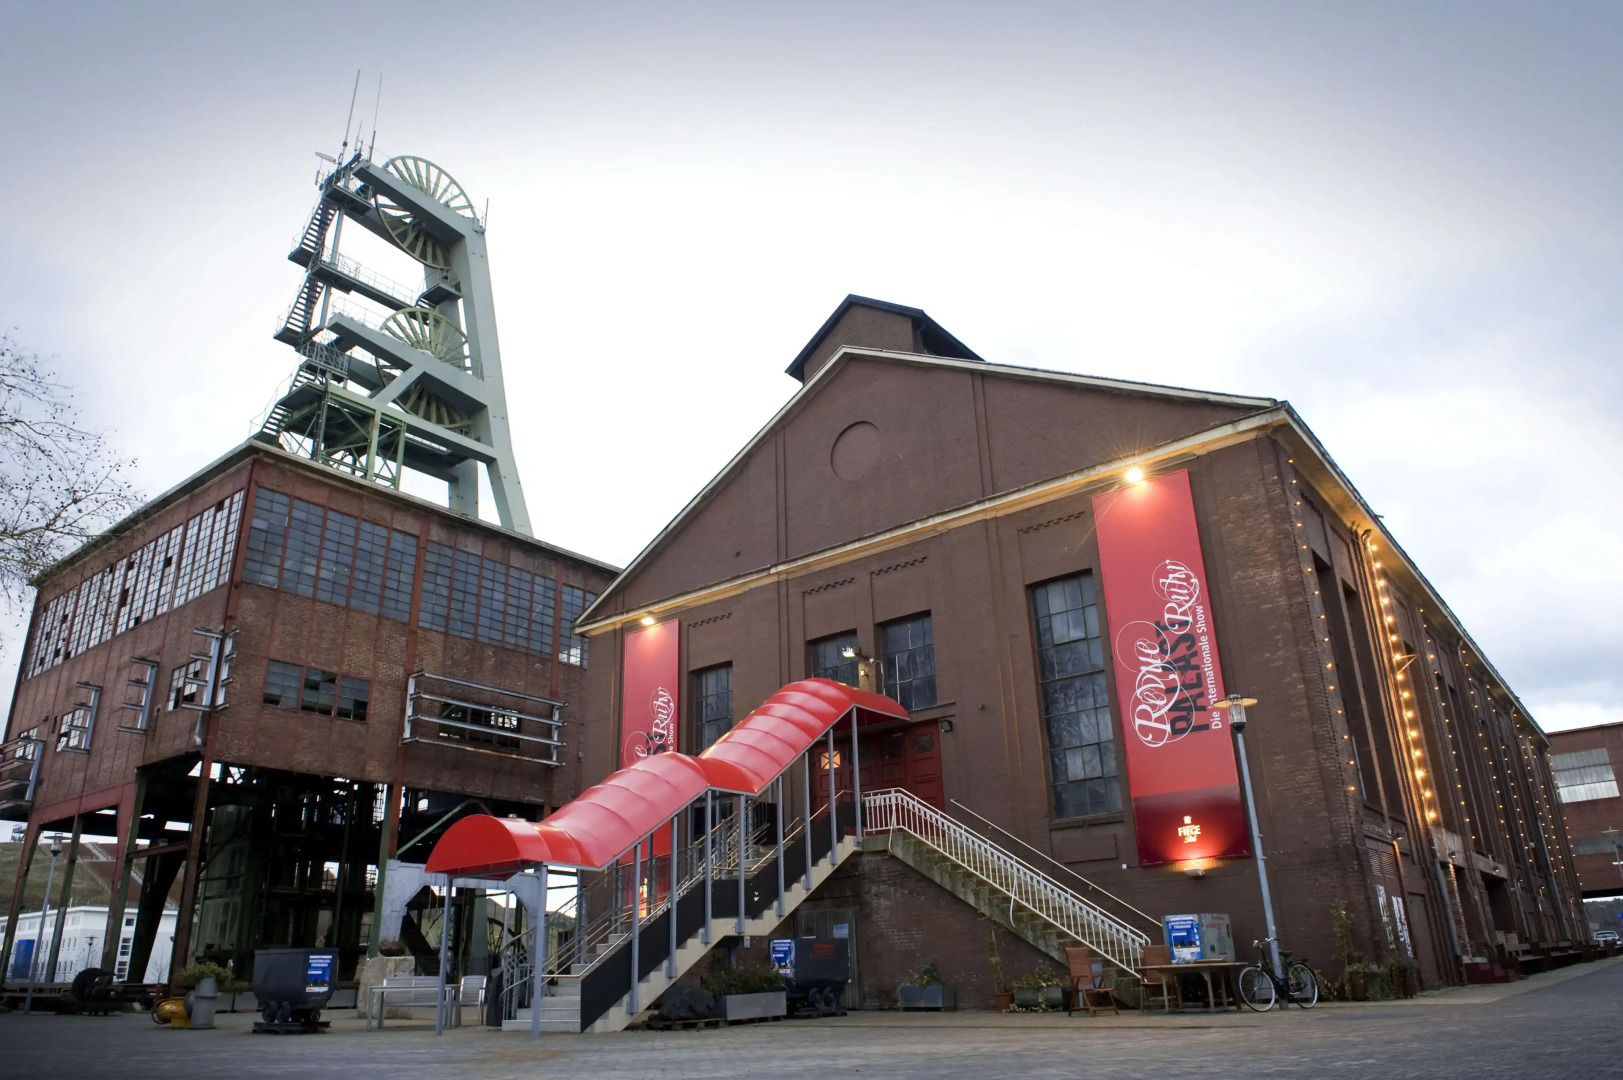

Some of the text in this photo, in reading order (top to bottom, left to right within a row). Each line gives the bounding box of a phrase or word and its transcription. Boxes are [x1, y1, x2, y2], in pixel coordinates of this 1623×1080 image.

[1152, 559, 1201, 635] Ruhr
[1196, 605, 1207, 633] Show
[1116, 621, 1195, 747] Revue
[1155, 620, 1209, 736] PALAST
[649, 687, 674, 744] Ruhr
[1210, 711, 1222, 729] Die
